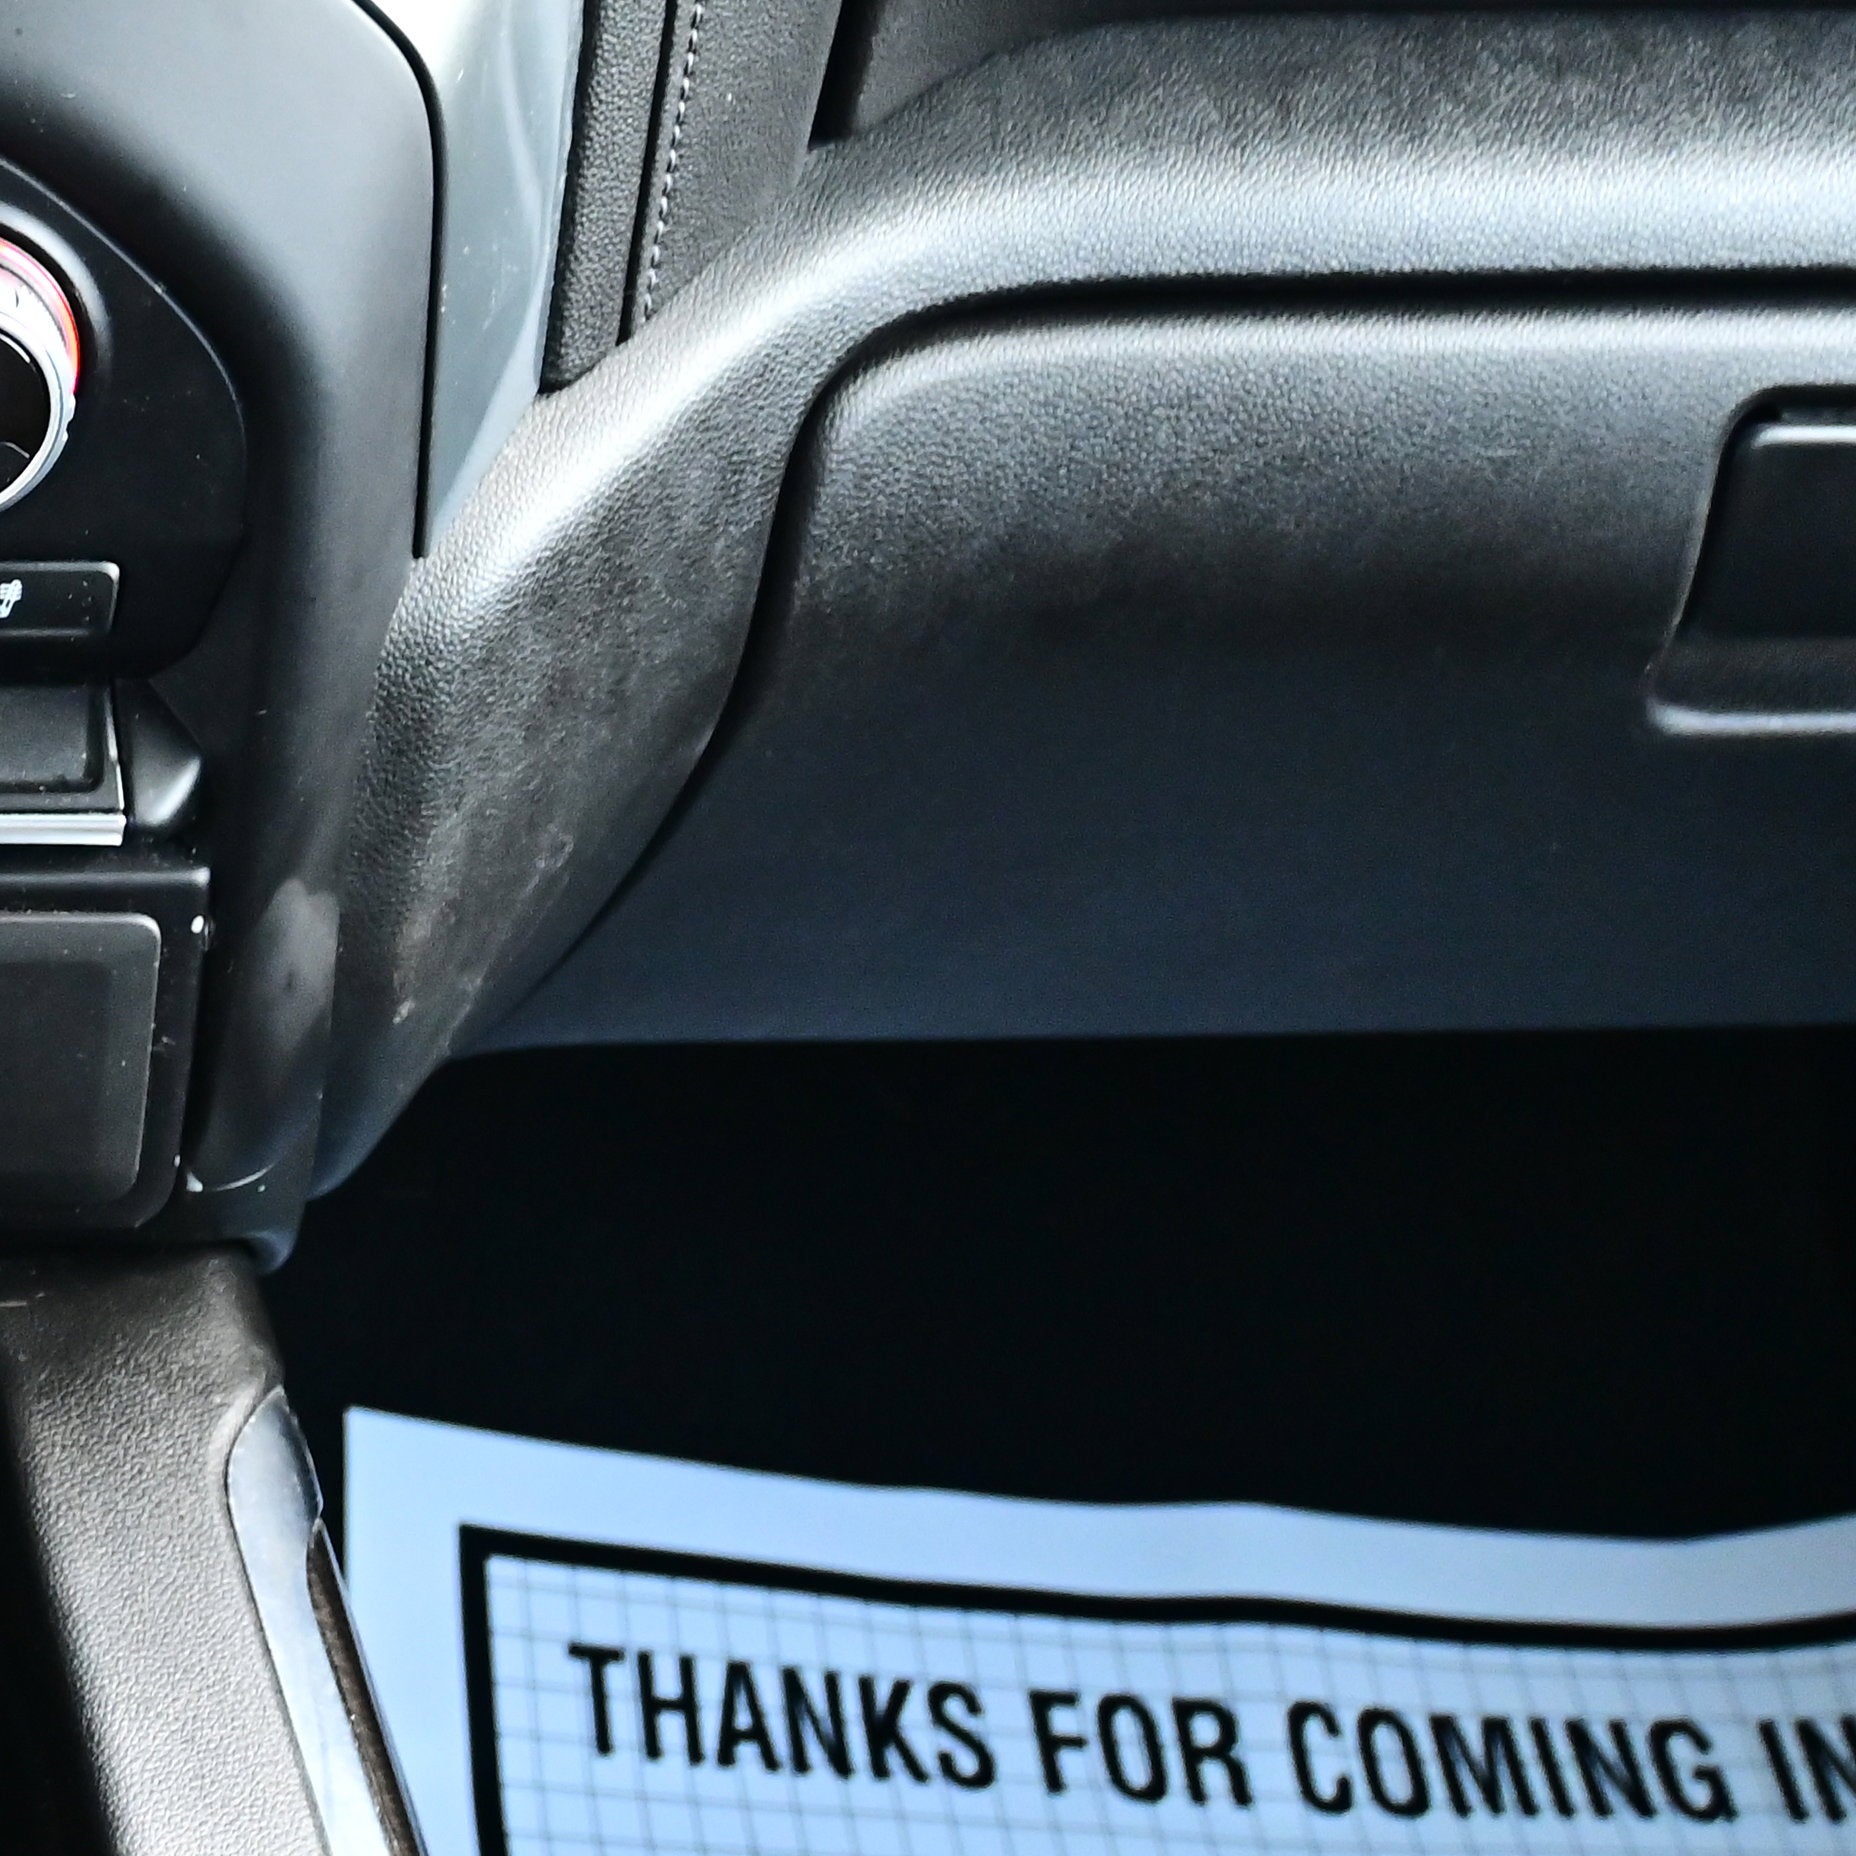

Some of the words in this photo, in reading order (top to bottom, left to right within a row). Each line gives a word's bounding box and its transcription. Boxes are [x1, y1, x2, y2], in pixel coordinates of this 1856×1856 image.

[569, 1642, 997, 1788] THANKS
[1023, 1689, 1253, 1810] FOR
[1283, 1699, 1738, 1824] COMING
[1756, 1712, 1856, 1824] IN
